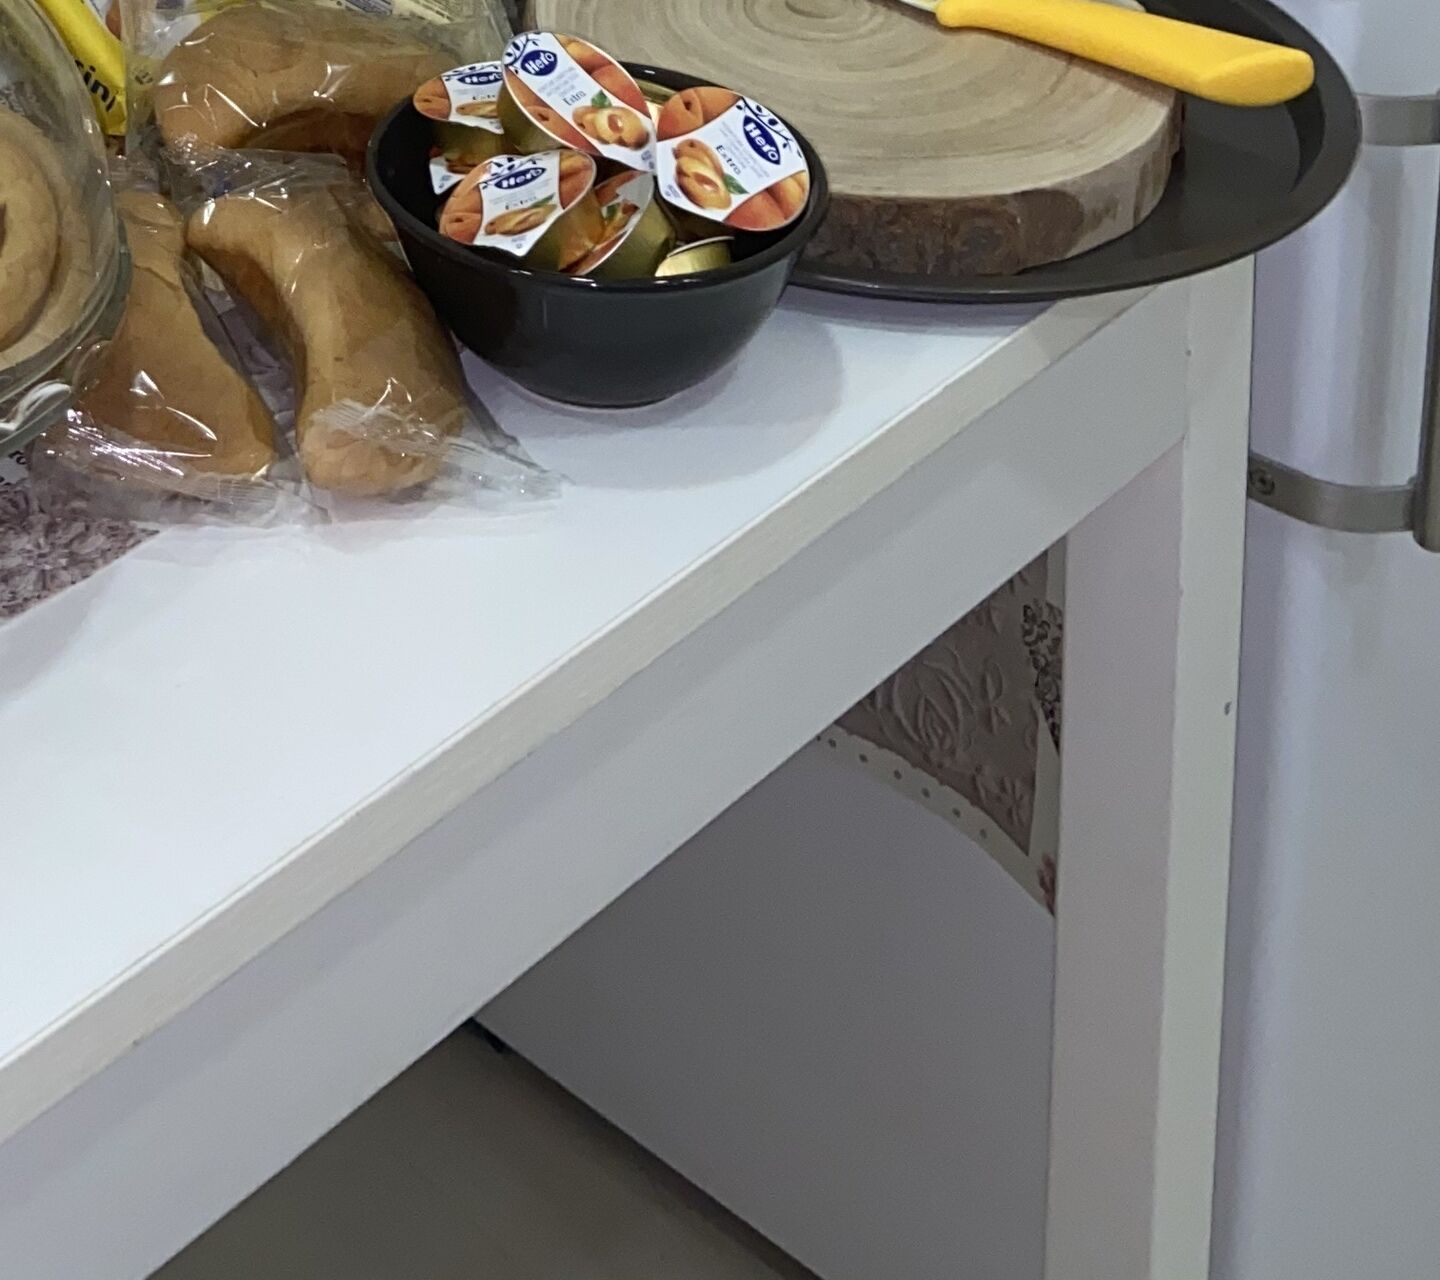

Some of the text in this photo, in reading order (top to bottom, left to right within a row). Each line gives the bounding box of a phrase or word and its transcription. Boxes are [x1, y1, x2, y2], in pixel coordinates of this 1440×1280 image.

[524, 52, 555, 75] Hero
[744, 121, 780, 162] Hero
[716, 144, 742, 176] Extra
[502, 167, 543, 189] Hero
